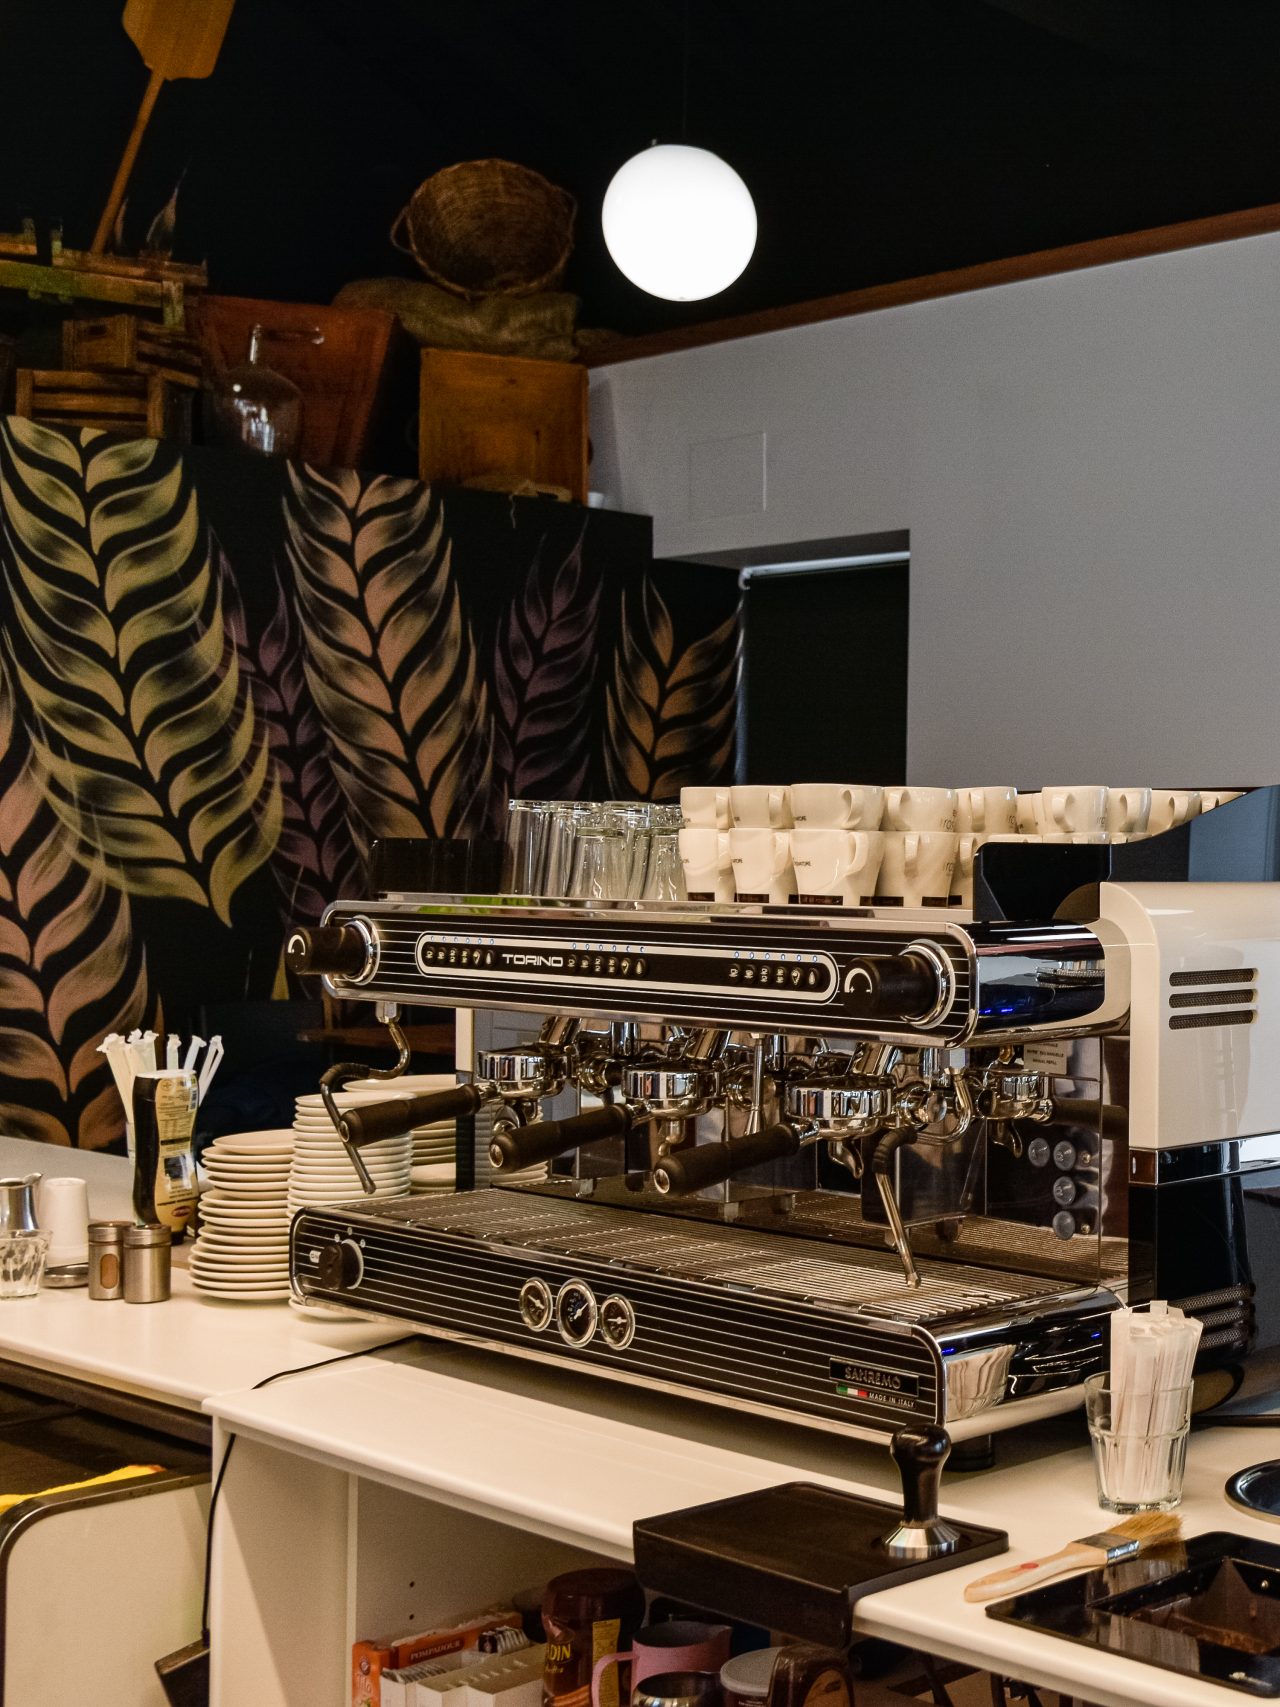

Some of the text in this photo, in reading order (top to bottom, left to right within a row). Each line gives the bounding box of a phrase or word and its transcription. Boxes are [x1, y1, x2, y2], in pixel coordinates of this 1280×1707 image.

[502, 954, 563, 967] TORINO
[844, 1366, 901, 1390] SANREMO
[868, 1392, 887, 1402] MADE
[898, 1398, 915, 1408] ITALY
[410, 1640, 461, 1660] POMPADOUR
